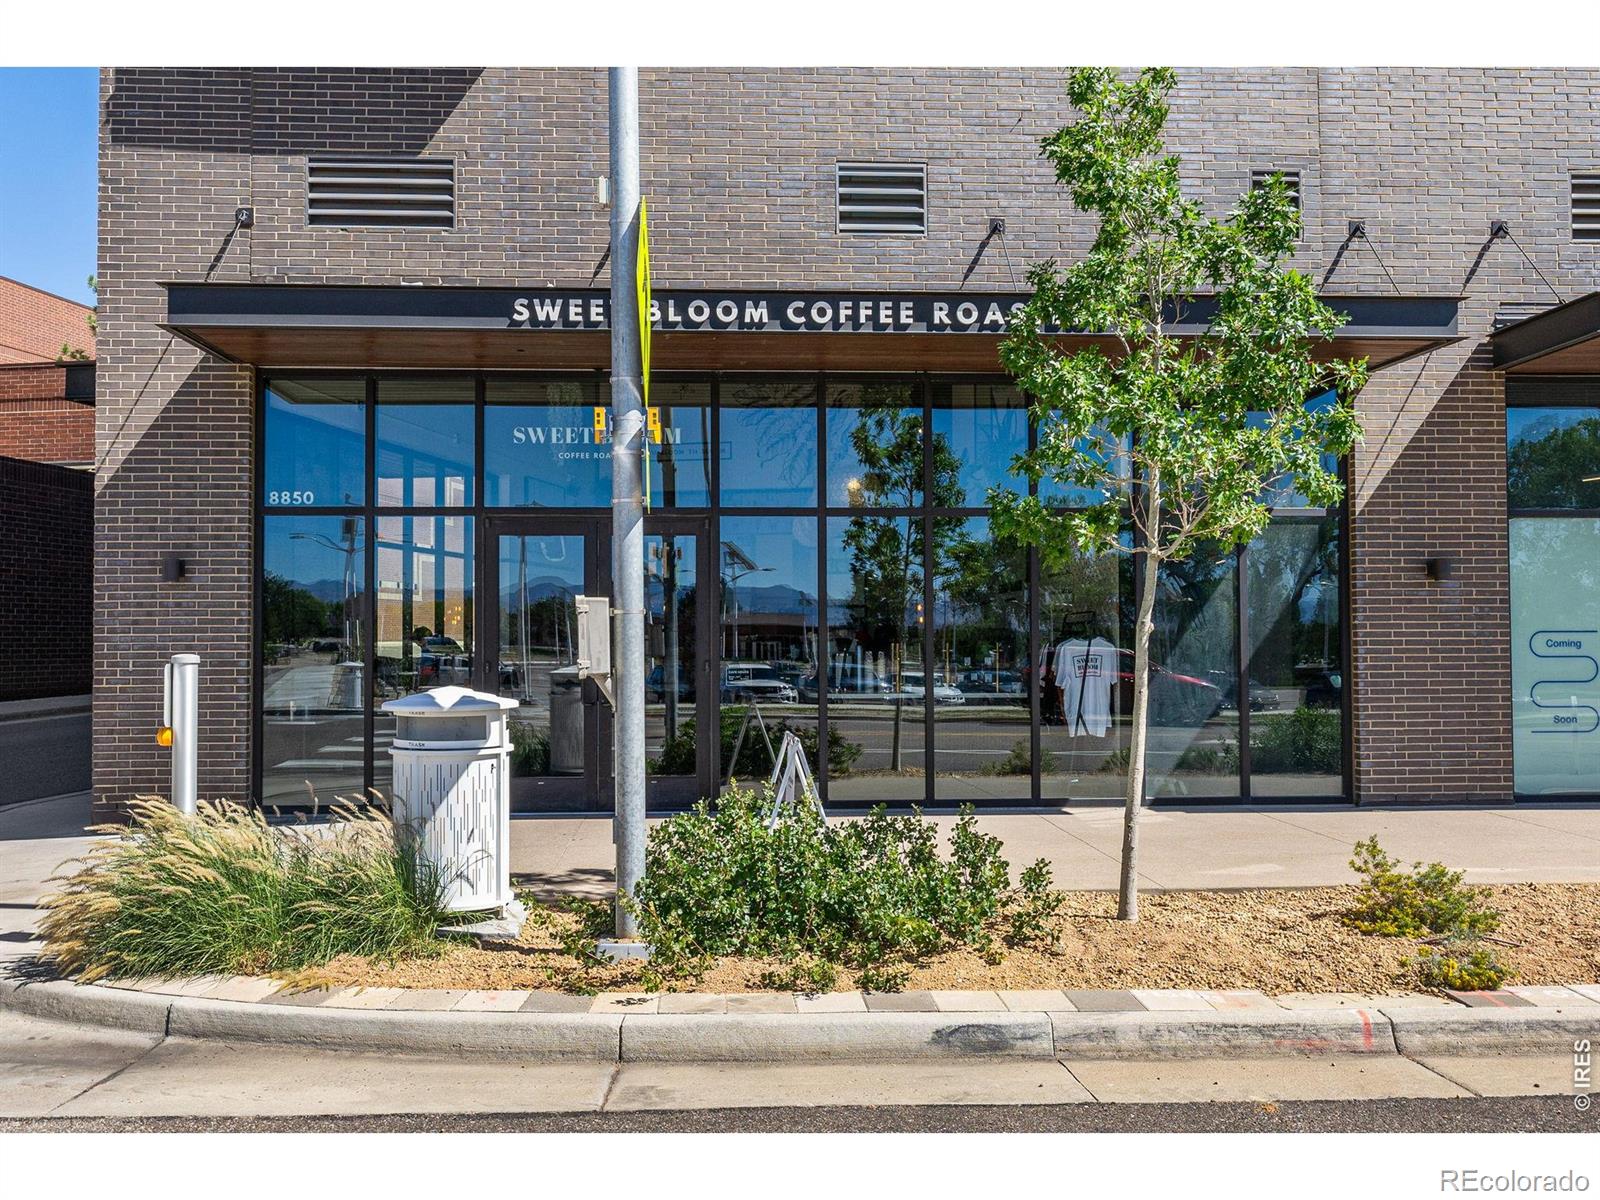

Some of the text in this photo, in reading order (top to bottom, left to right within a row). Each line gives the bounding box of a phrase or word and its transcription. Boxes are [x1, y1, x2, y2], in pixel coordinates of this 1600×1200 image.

[511, 298, 612, 321] SWEE
[786, 301, 914, 324] COFFEE
[512, 427, 594, 444] SWEET
[269, 491, 314, 505] 8850
[1545, 638, 1582, 650] Coming
[1553, 715, 1578, 724] Soon
